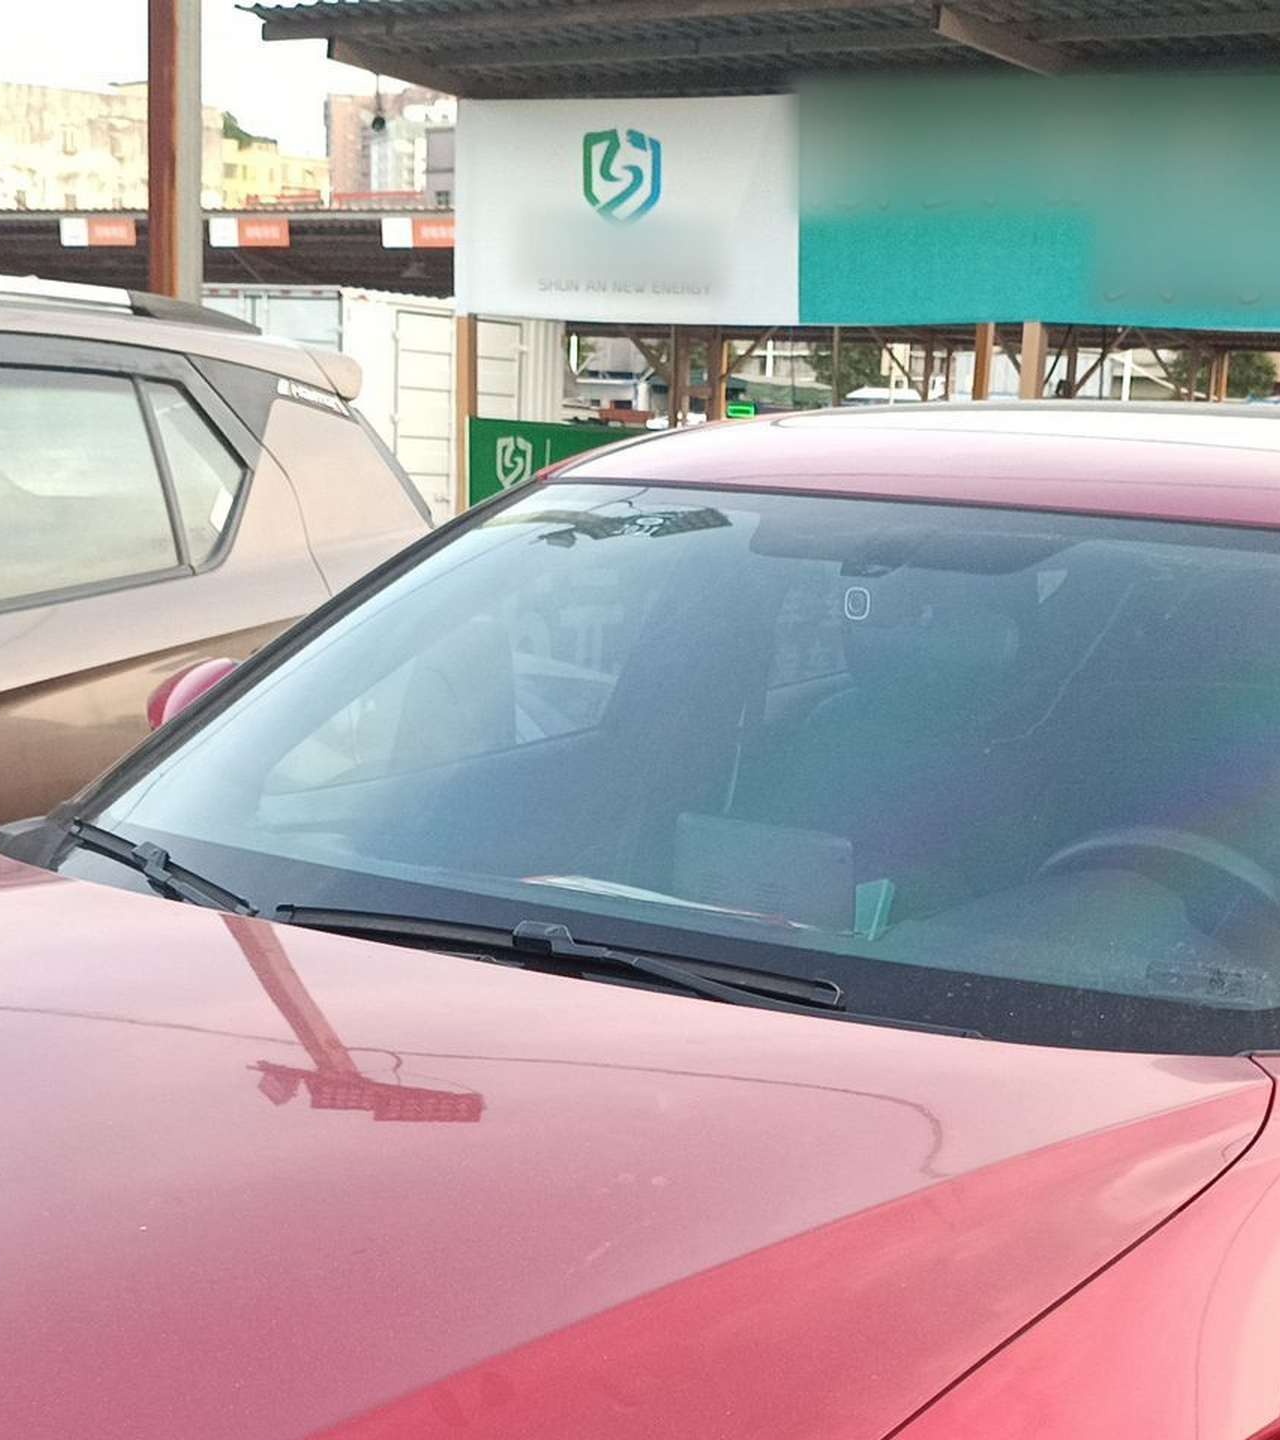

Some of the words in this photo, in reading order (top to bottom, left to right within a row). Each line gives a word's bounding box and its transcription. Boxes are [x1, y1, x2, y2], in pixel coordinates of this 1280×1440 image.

[537, 278, 580, 292] SHUN
[585, 279, 607, 293] AN
[612, 280, 646, 294] NEW
[651, 280, 712, 295] ENERGY
